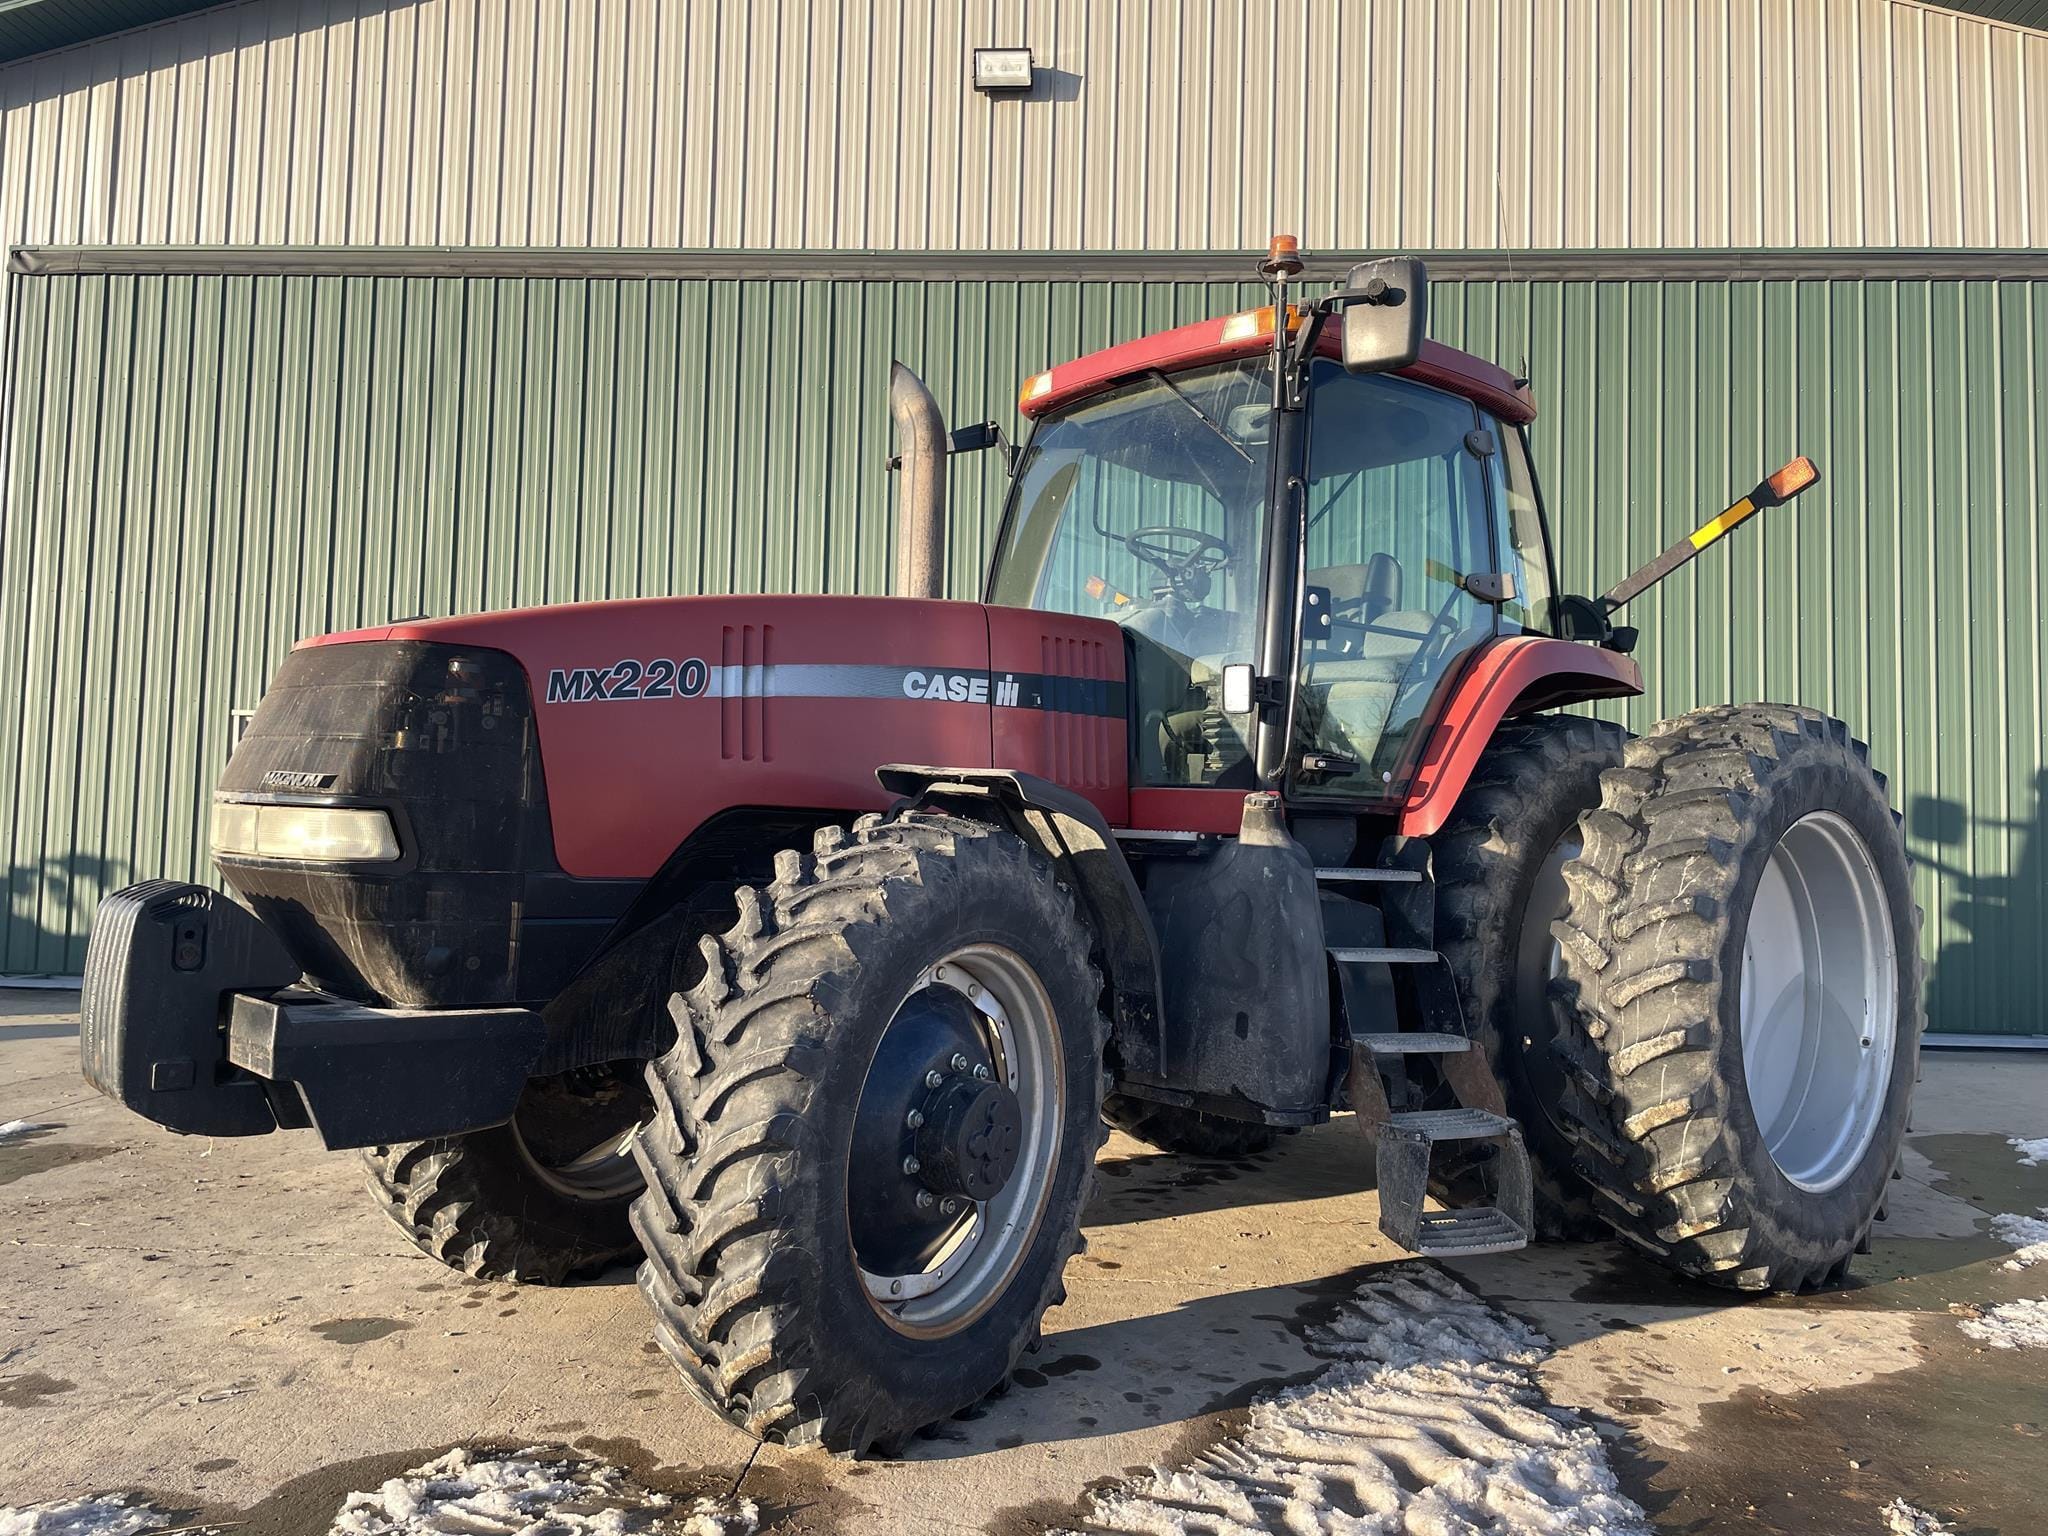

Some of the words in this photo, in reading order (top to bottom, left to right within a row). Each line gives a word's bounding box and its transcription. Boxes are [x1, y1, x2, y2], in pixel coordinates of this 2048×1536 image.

[546, 657, 708, 703] MX220
[902, 671, 989, 704] CASE
[262, 771, 323, 788] MAGNUM
